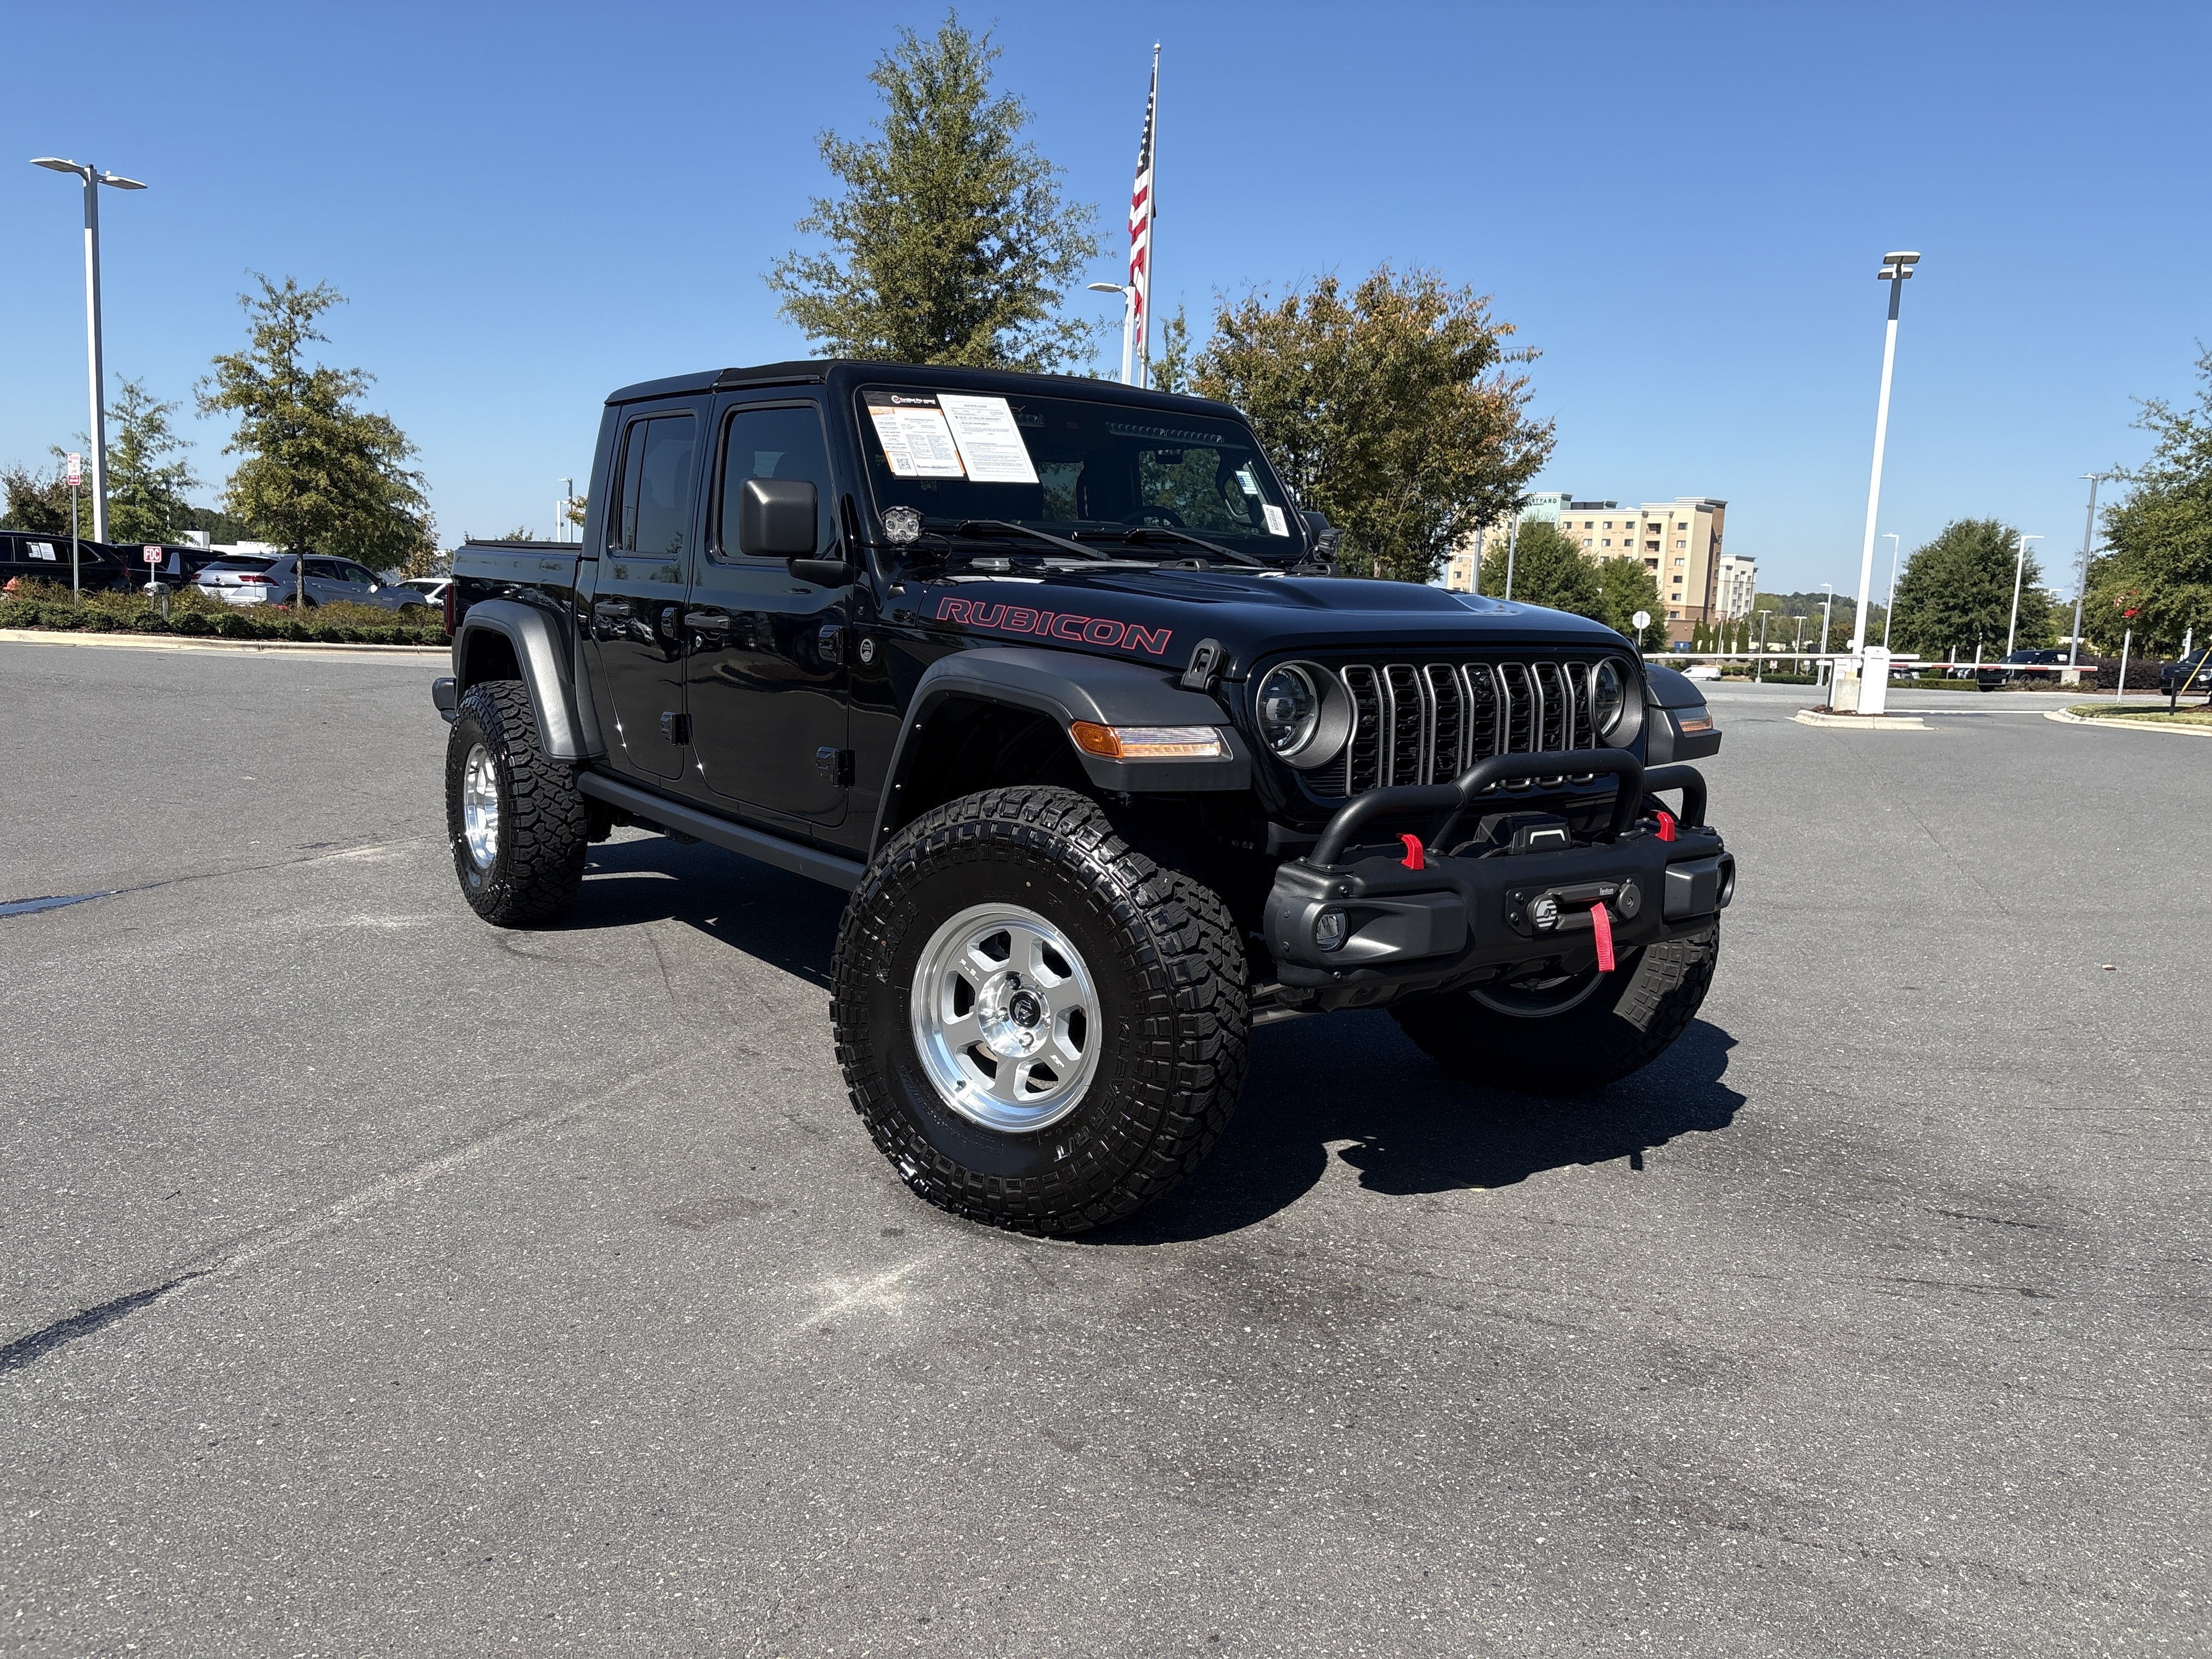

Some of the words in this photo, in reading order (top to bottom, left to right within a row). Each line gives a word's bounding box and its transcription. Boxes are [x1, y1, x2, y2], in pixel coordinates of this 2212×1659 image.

[145, 548, 160, 560] FDC
[936, 597, 1172, 654] RUBICON
[1090, 1015, 1130, 1130] KLEVER
[1054, 1125, 1093, 1163] R/T
